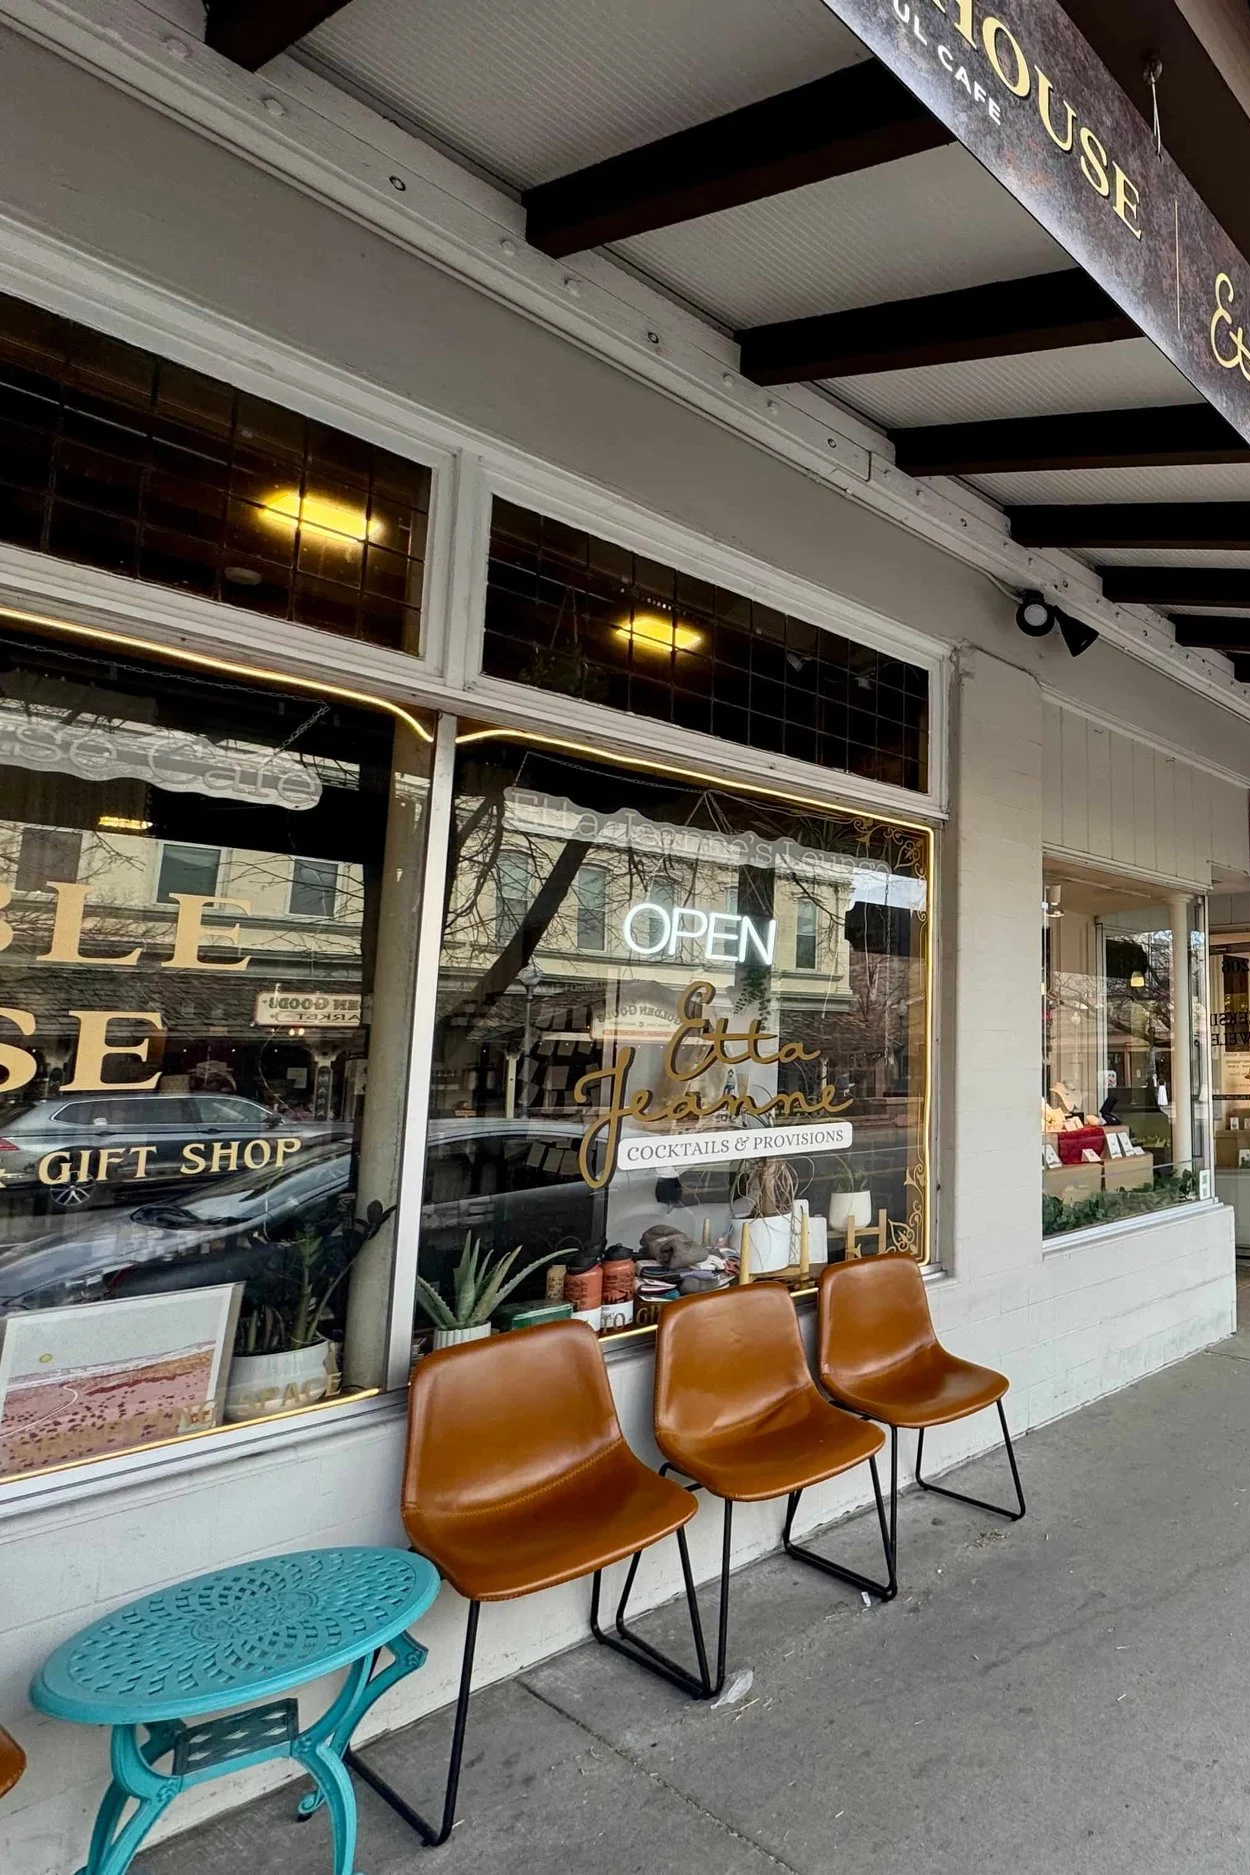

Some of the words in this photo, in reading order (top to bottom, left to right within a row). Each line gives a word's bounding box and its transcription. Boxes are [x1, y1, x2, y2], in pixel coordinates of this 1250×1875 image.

[937, 45, 1001, 126] CAFE
[0, 882, 251, 971] LE
[624, 902, 777, 966] OPEN
[665, 981, 821, 1082] Etta
[574, 1046, 854, 1190] Jeanne
[627, 1139, 730, 1162] COCKTAILS
[735, 1136, 750, 1152] &
[753, 1129, 844, 1150] PROVISIONS
[38, 1146, 157, 1185] GIFT
[180, 1137, 302, 1175] SHOP
